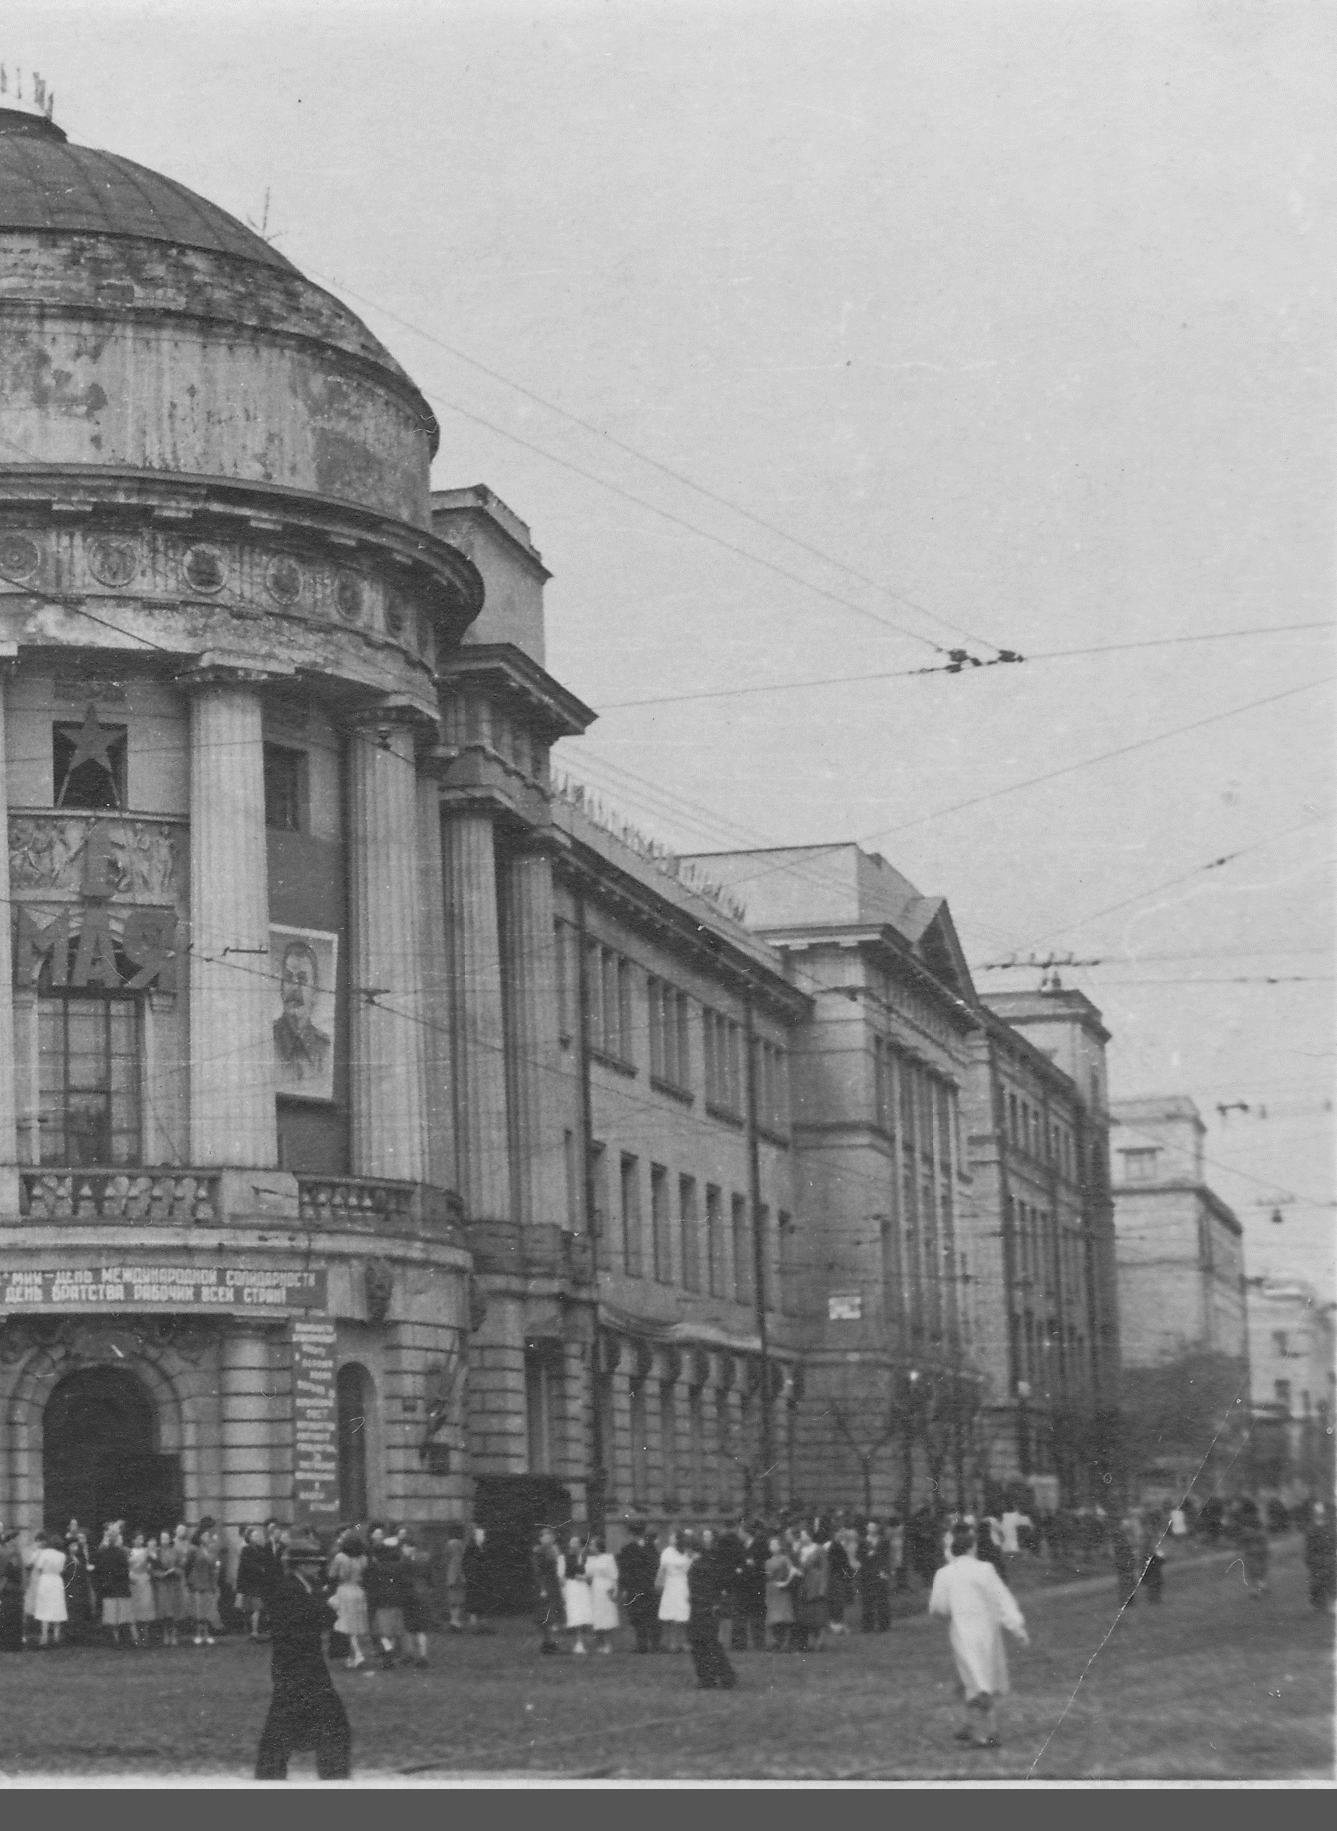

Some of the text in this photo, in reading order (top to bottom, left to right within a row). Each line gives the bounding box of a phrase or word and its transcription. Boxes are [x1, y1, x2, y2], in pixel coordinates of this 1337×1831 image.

[16, 903, 178, 990] МАЯ
[101, 1267, 217, 1286] МЕЖДУНАРОДНОЙ
[226, 1270, 315, 1287] СОЛИДАРНОСТИ
[5, 1285, 43, 1303] ДЕНЬ
[52, 1284, 124, 1302] БРАТСТВА
[134, 1283, 194, 1301] РАБОЧИХ
[201, 1285, 234, 1302] ВСЕХ
